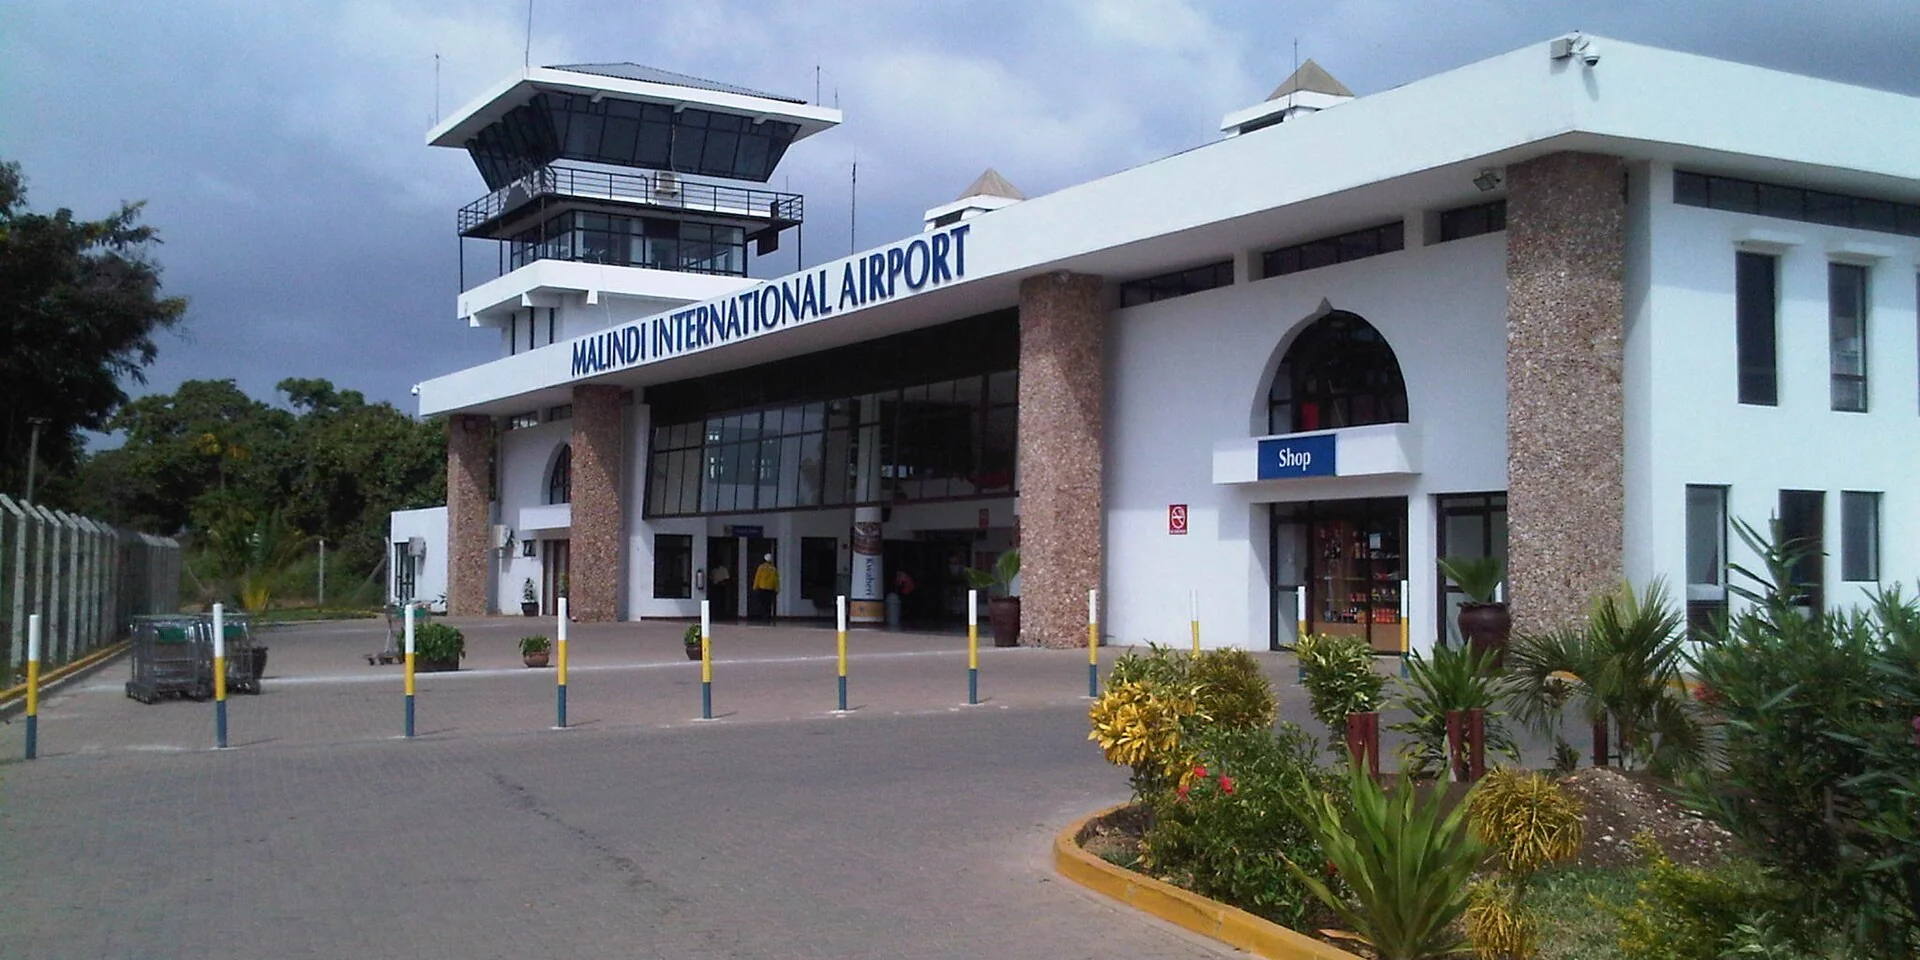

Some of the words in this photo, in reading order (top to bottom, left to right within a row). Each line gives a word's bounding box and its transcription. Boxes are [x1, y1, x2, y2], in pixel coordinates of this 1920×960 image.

[571, 328, 646, 377] MALINDI
[652, 269, 832, 358] INTERNATIONAL
[839, 224, 970, 310] AIRPORT
[1279, 447, 1312, 472] Shop
